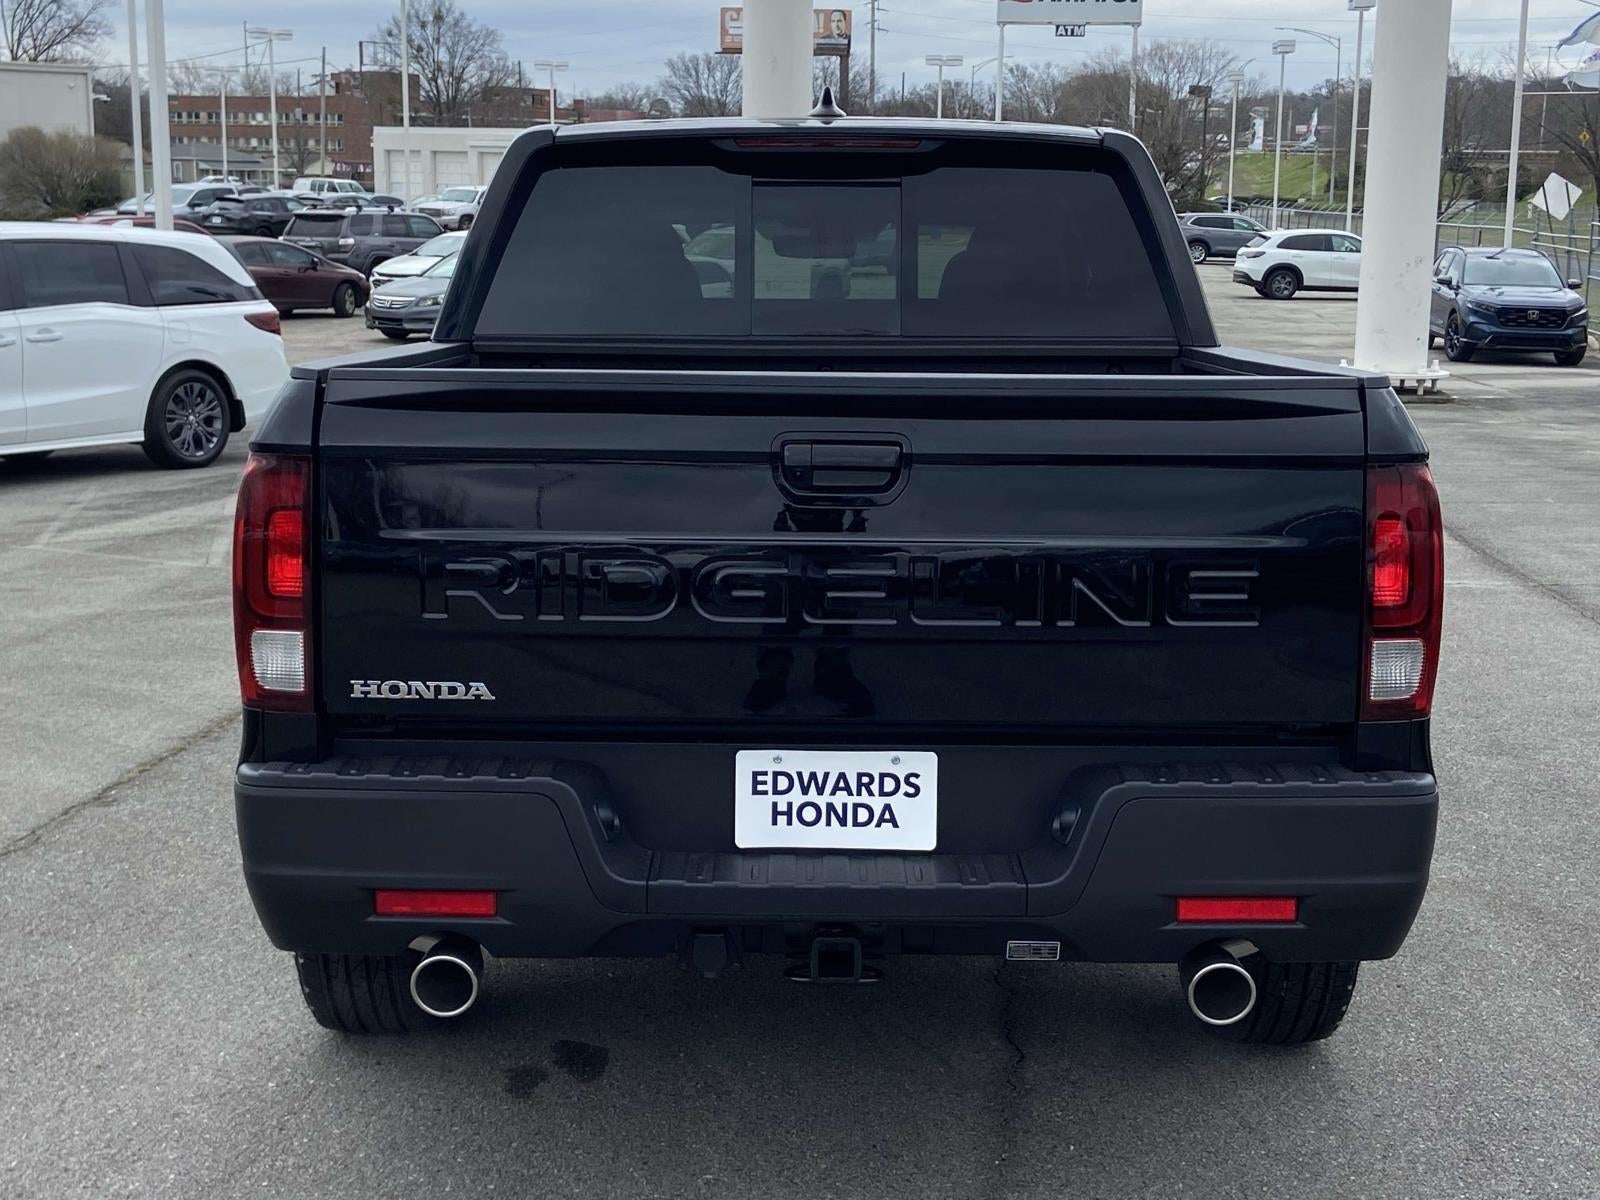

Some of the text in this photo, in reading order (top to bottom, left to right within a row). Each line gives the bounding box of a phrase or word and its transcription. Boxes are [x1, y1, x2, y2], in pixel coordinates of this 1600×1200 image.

[1056, 25, 1085, 37] ATM
[418, 549, 1261, 627] RIDGELINE
[350, 680, 496, 700] HONDA
[751, 770, 921, 798] EDWARDS
[771, 801, 900, 828] HONDA
